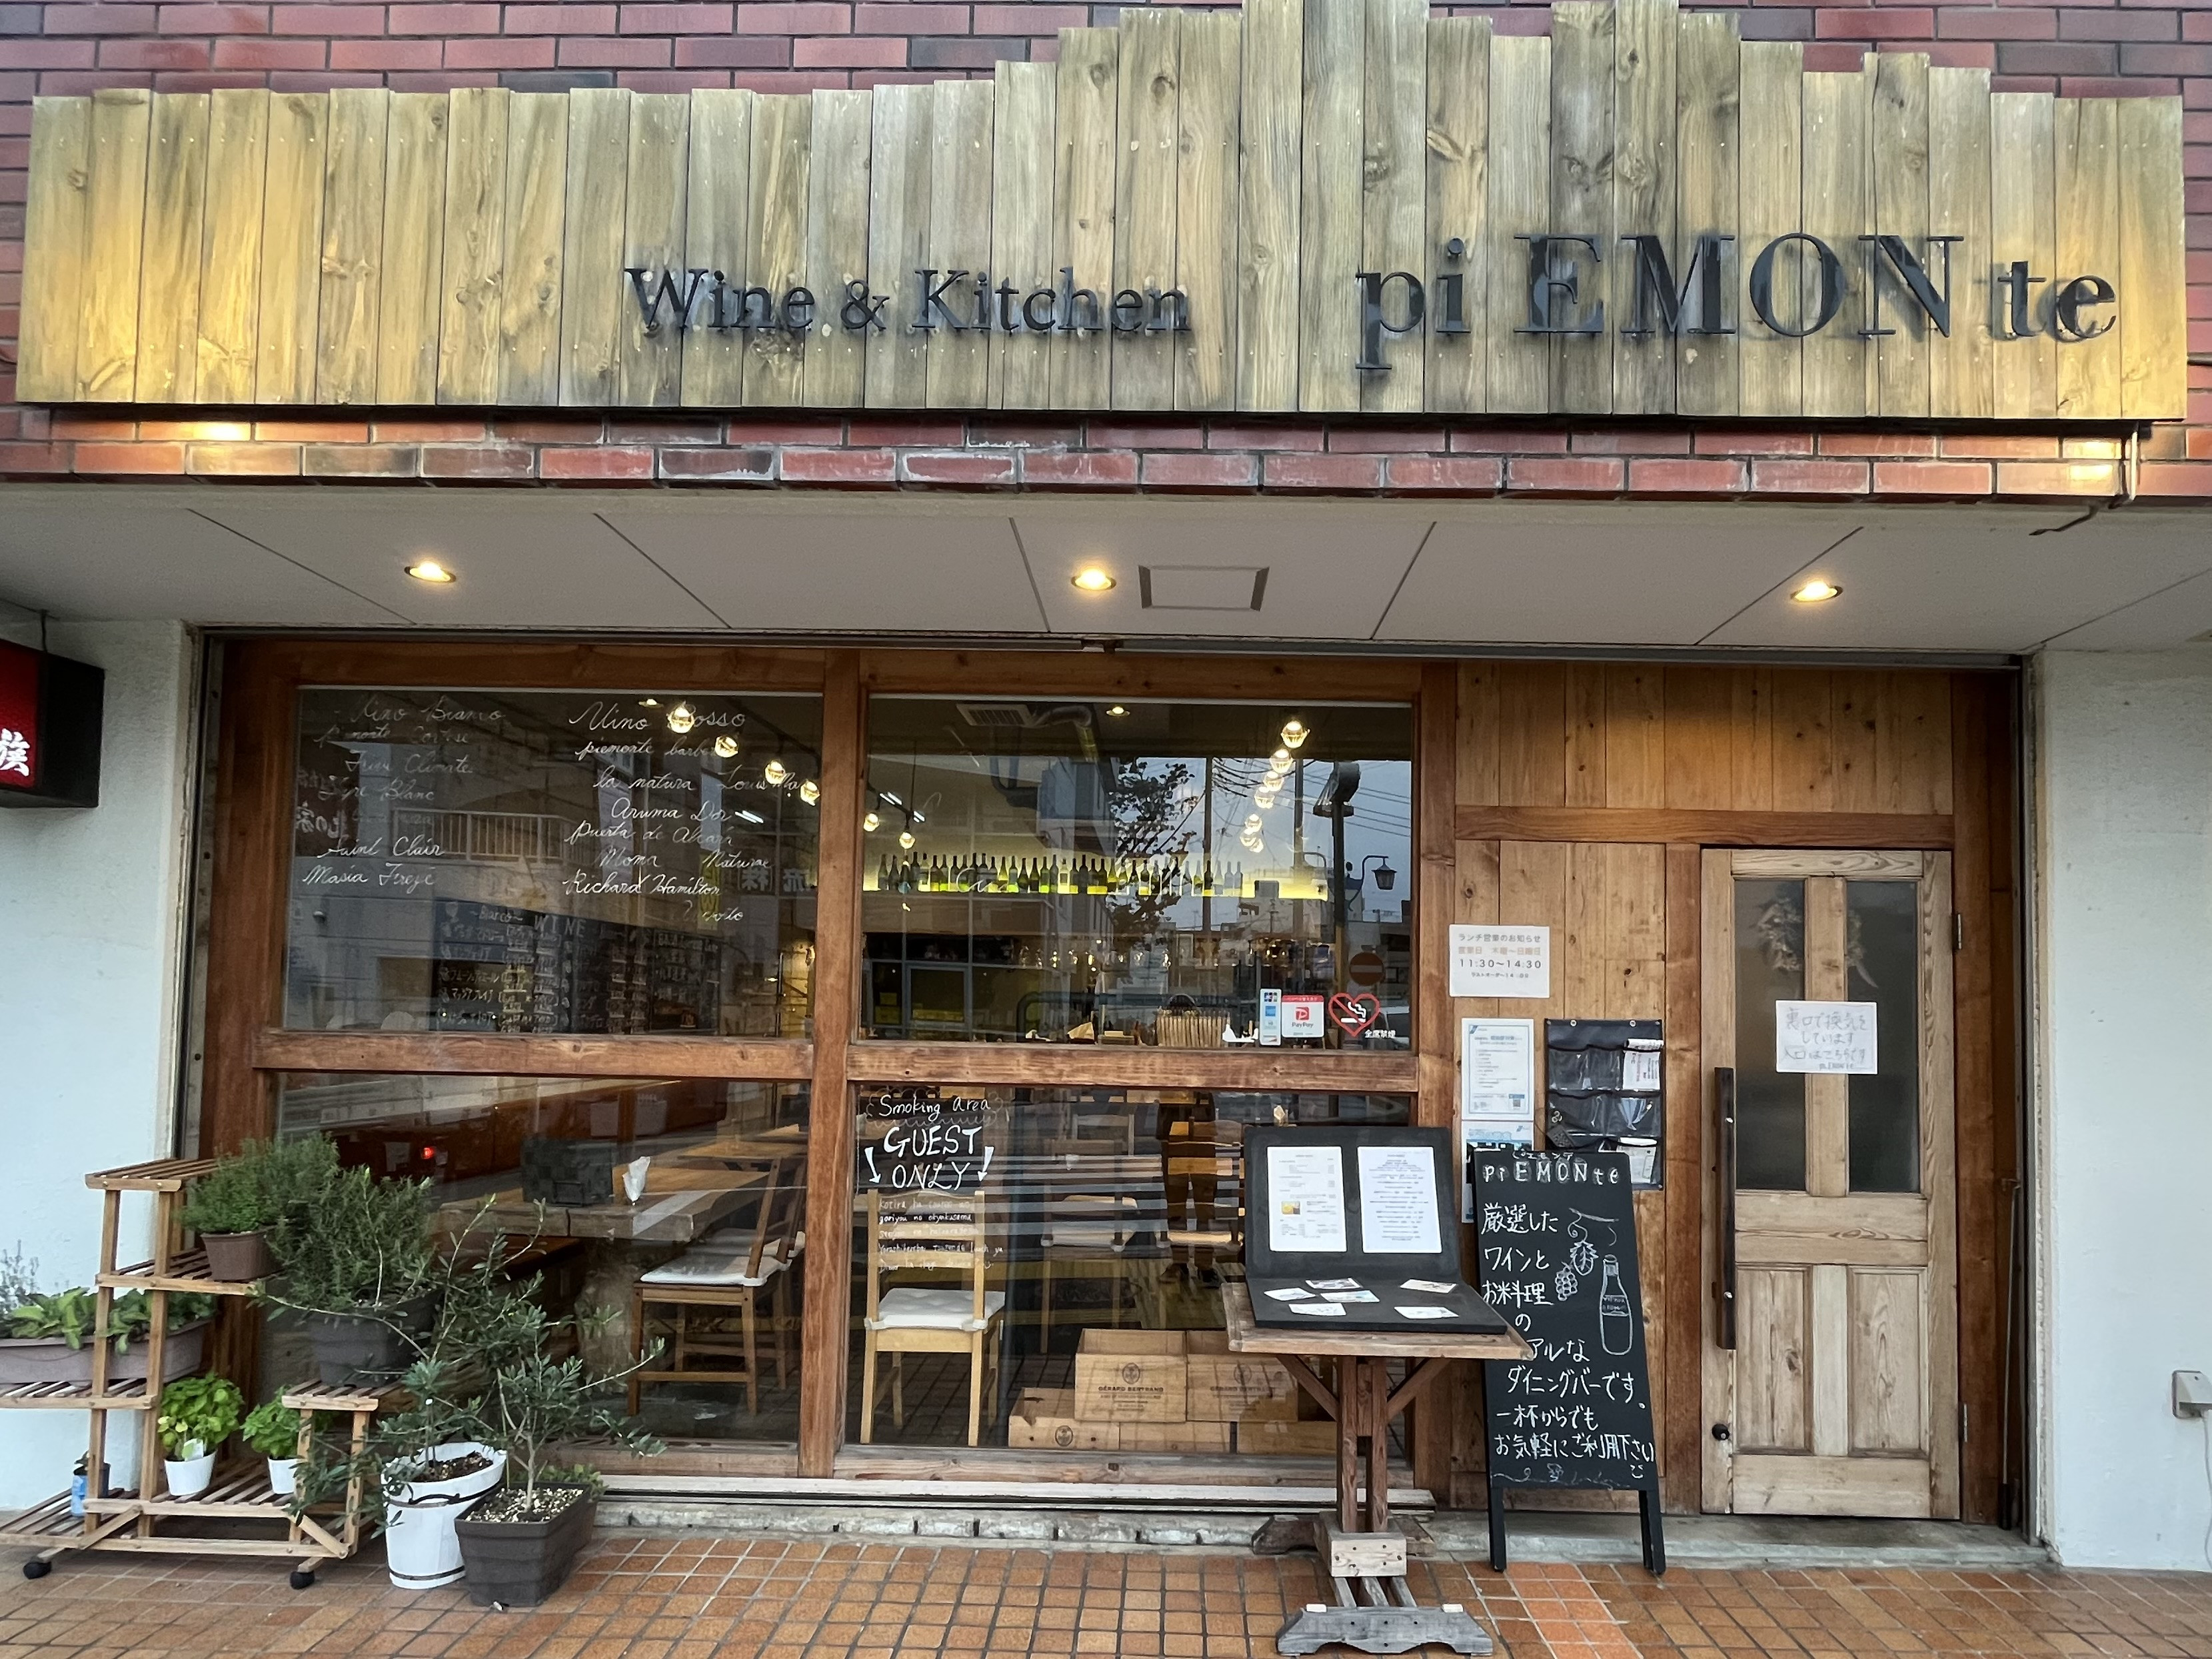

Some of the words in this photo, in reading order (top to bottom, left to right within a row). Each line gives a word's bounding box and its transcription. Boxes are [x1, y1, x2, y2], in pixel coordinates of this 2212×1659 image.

[624, 267, 816, 331] Wine
[840, 279, 890, 331] &
[912, 267, 1192, 332] Kitchen
[879, 1094, 940, 1121] Smoking
[884, 1124, 982, 1158] GUEST
[892, 1162, 970, 1190] ONLY
[1481, 1202, 1559, 1234] 厳選した
[1484, 1246, 1550, 1272] ワインと
[1482, 1280, 1554, 1309] お料理
[1515, 1314, 1532, 1332] の
[1496, 1404, 1599, 1431] 一杯からでも
[1494, 1432, 1655, 1462] お気軽にご利用下さい
